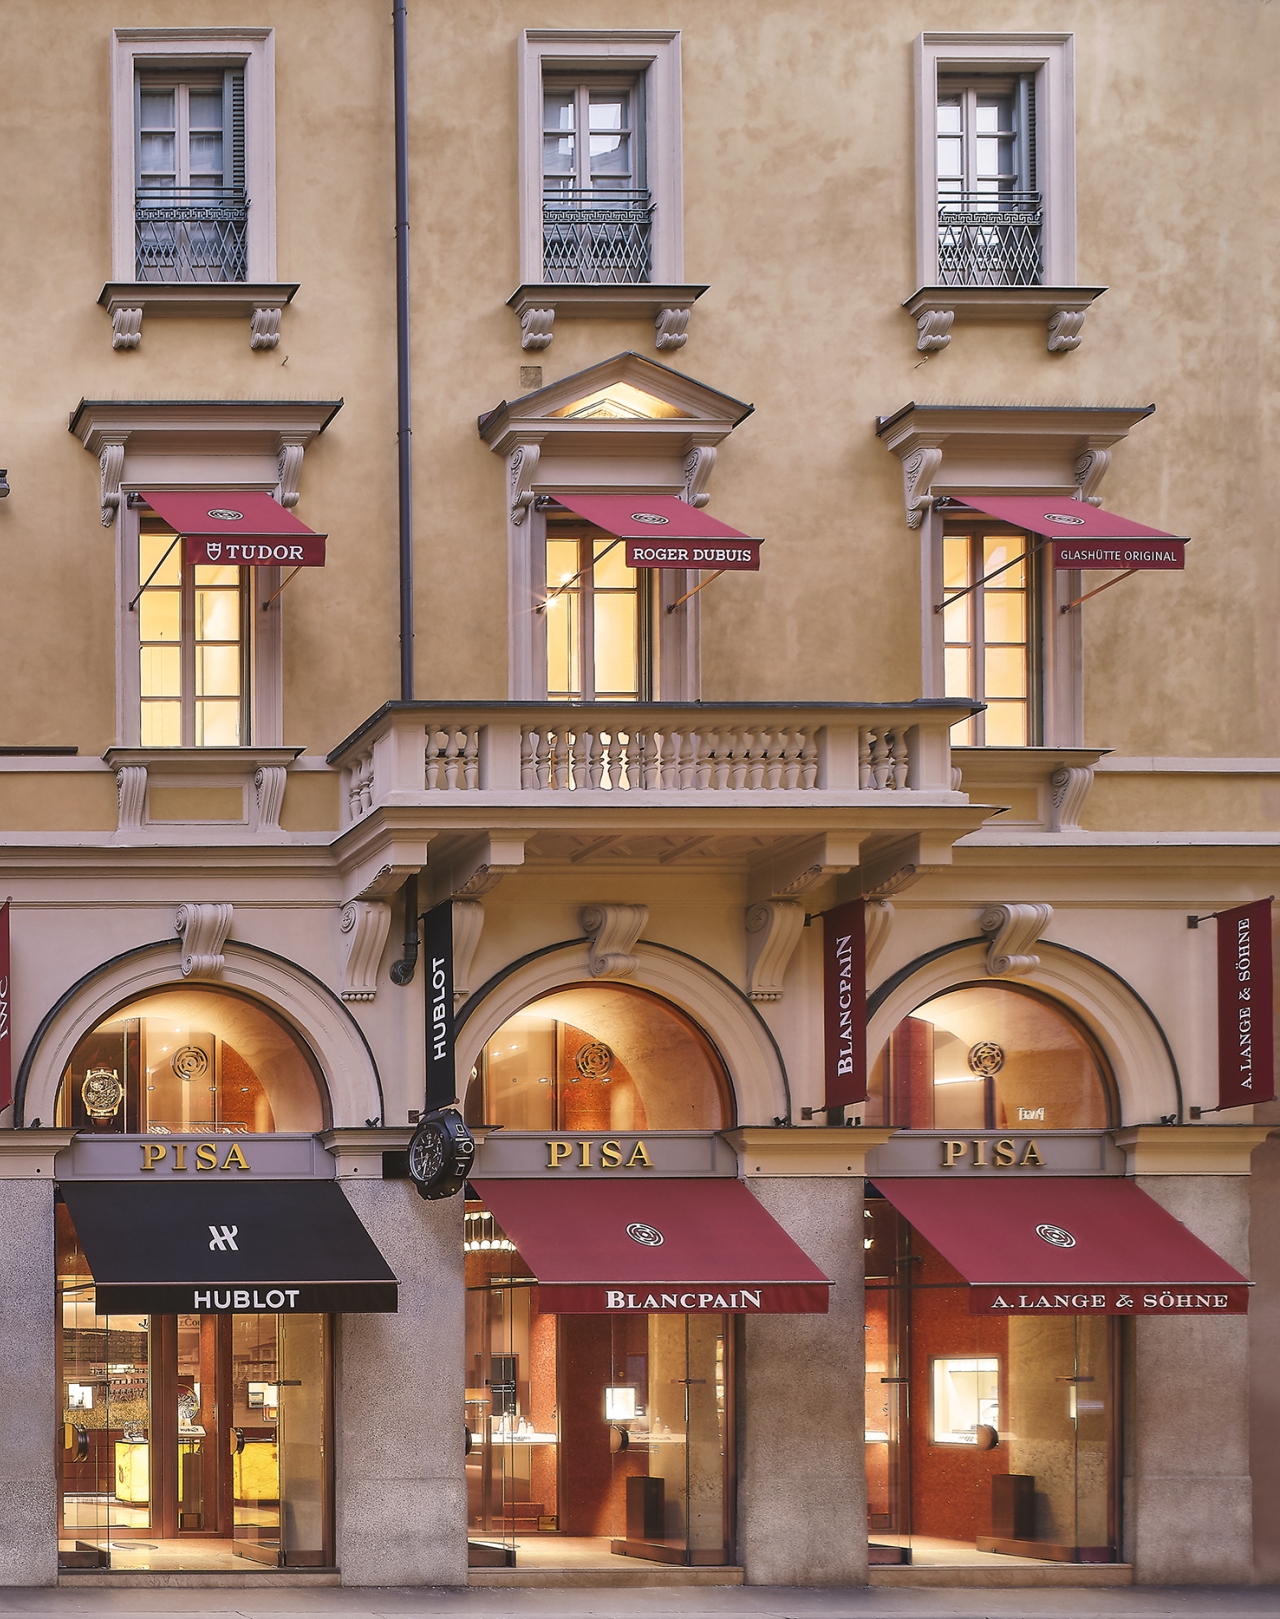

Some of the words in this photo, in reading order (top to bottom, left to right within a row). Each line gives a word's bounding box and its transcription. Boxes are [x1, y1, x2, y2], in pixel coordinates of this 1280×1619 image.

[225, 544, 304, 560] TUDOR
[633, 548, 689, 561] ROGER
[693, 549, 752, 562] DUBUIS
[1060, 549, 1121, 561] GLASHÜTTE
[1124, 550, 1177, 562] ORIGINAL
[1235, 917, 1251, 982] SÖHNE
[836, 935, 854, 1077] BLANCPAIN
[1238, 987, 1251, 1001] &
[0, 975, 9, 1041] IWC
[432, 957, 447, 1061] HUBLOT
[141, 1142, 251, 1171] PISA
[547, 1140, 654, 1169] PISA
[942, 1139, 1046, 1167] PISA
[194, 1289, 300, 1309] HUBLOT
[605, 1290, 762, 1309] BLANCPAIN
[1115, 1294, 1134, 1308] &
[1143, 1290, 1229, 1308] SÖHNE
